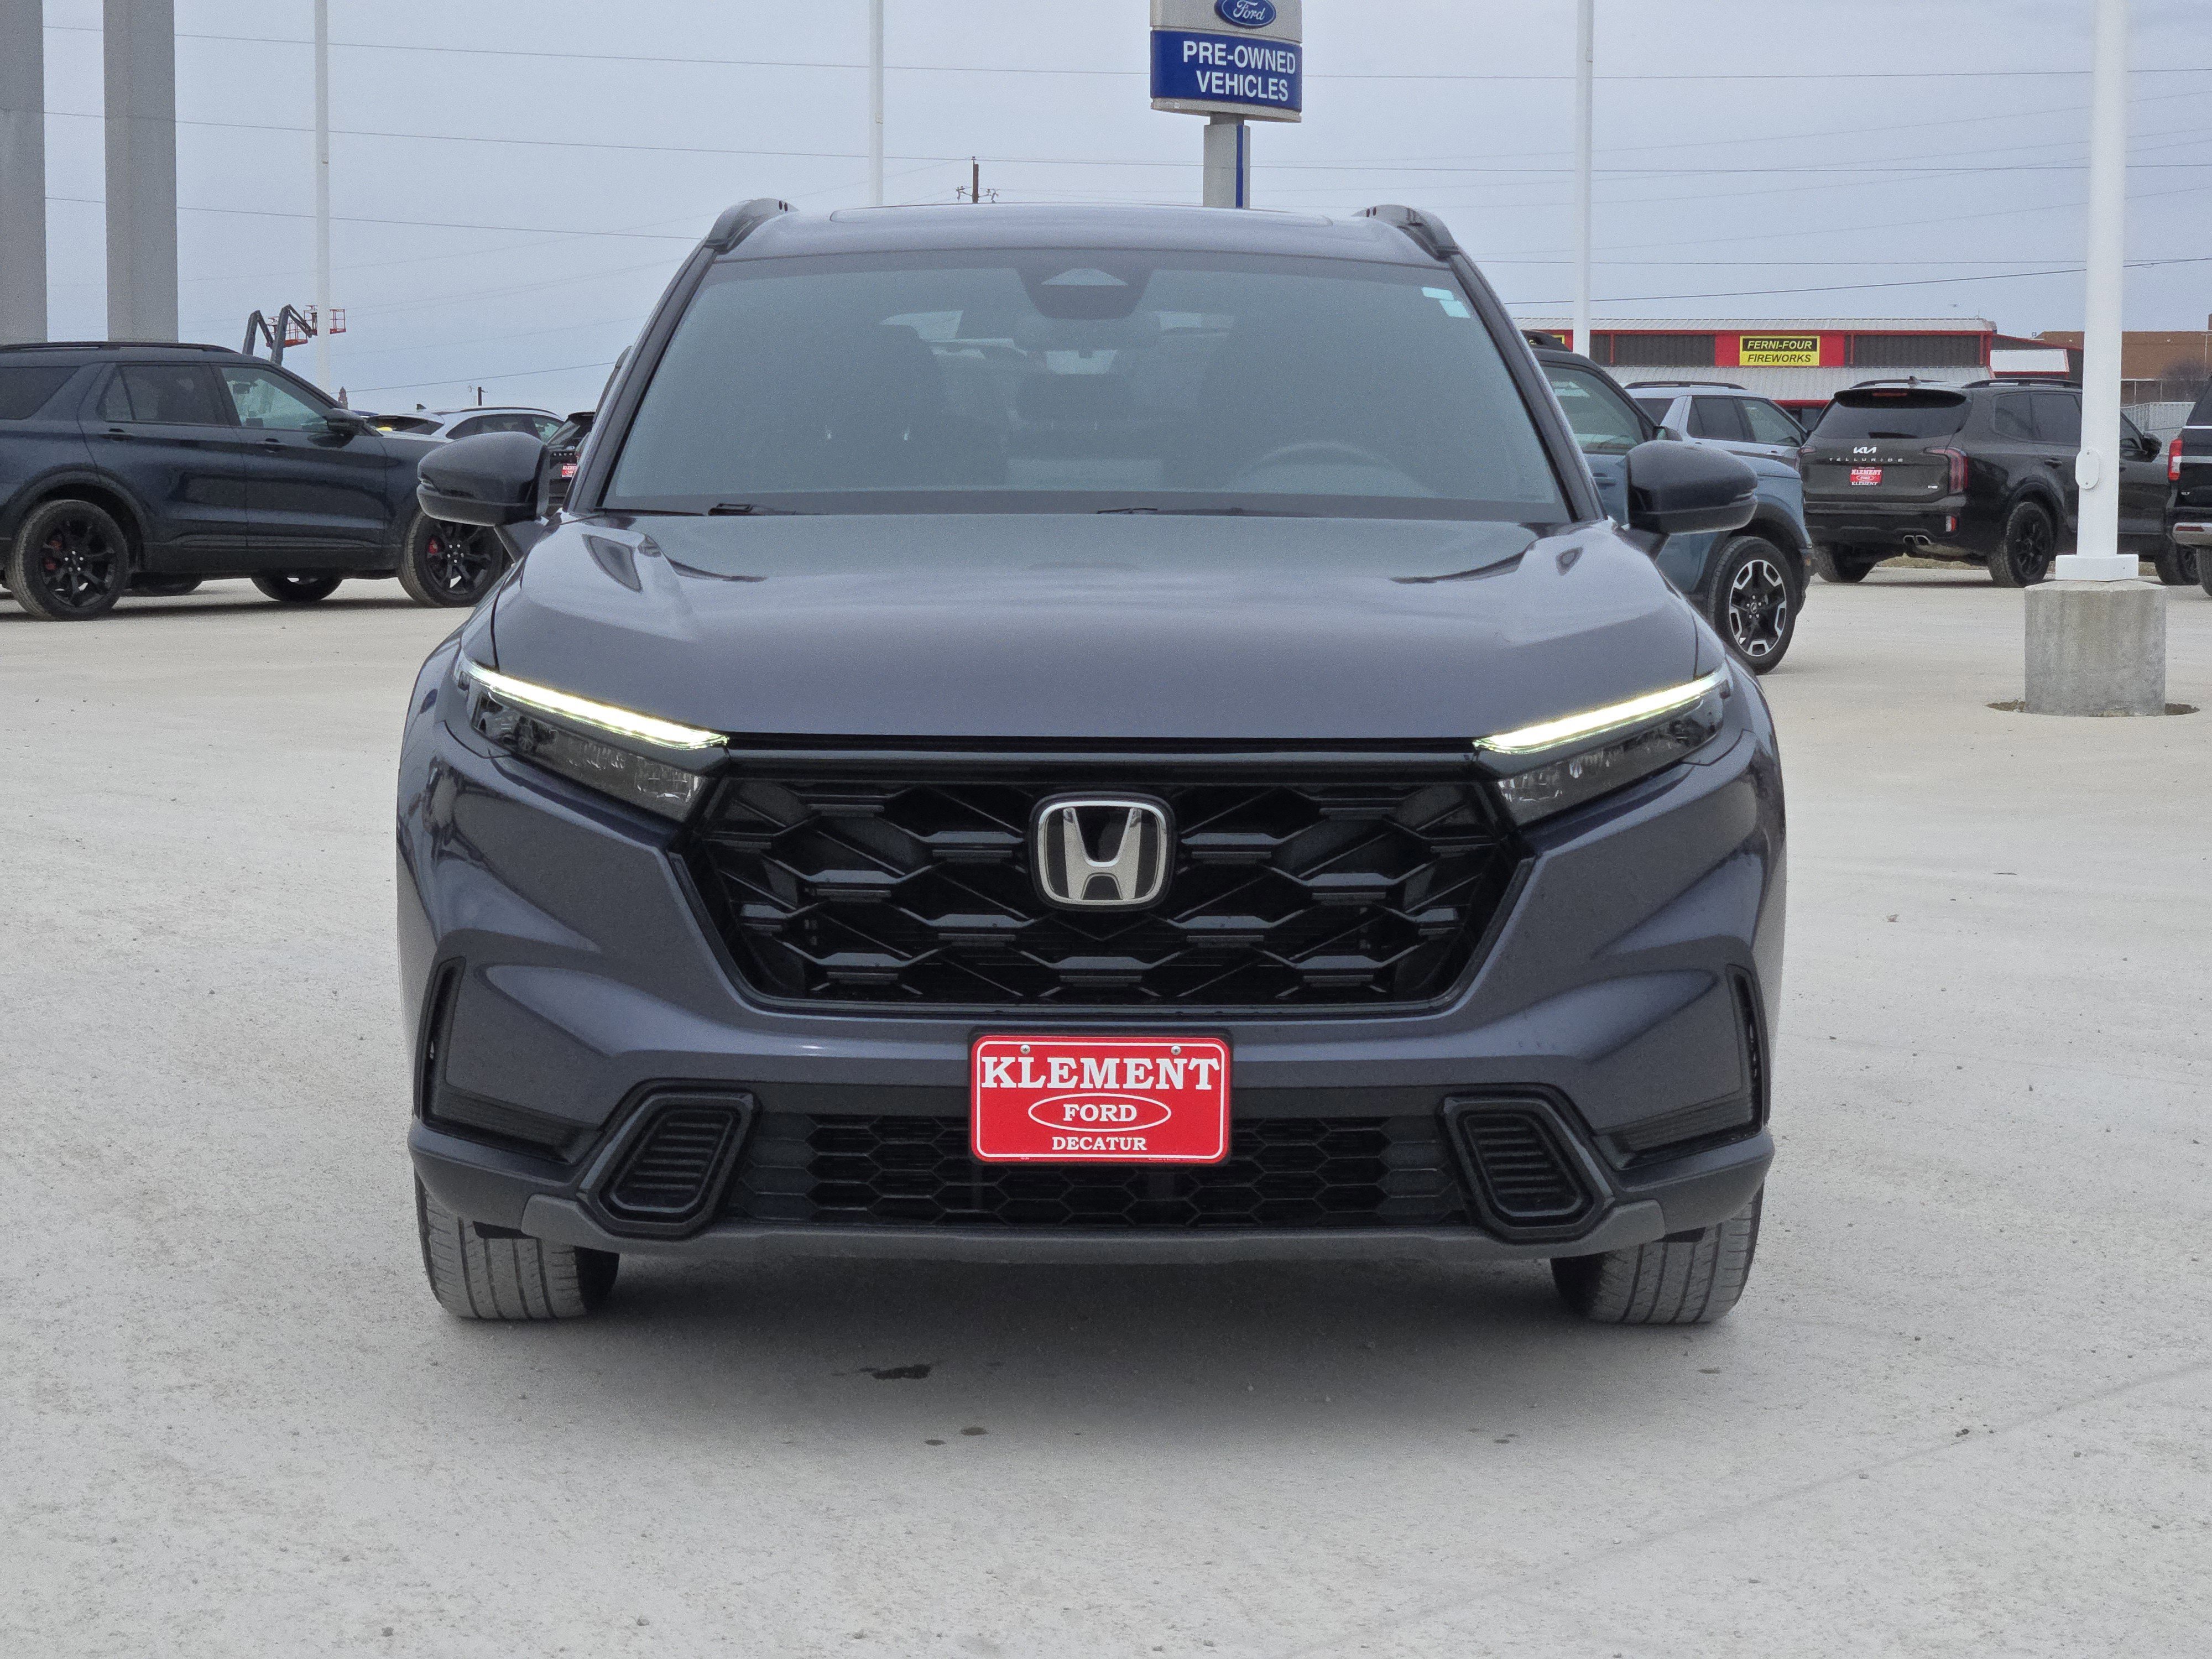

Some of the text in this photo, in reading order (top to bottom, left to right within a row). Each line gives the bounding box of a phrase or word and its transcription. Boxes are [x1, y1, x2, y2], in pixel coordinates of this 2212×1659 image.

[1233, 0, 1266, 20] Ford
[1183, 40, 1296, 75] PRE-OWNED
[1196, 70, 1288, 101] VEHICLES
[1747, 340, 1812, 349] FERNI-FOUR
[1747, 354, 1811, 363] FIREWORKS
[981, 1056, 1220, 1090] KLEMENT
[1063, 1104, 1137, 1122] FORD
[1052, 1136, 1147, 1151] DECATUR
